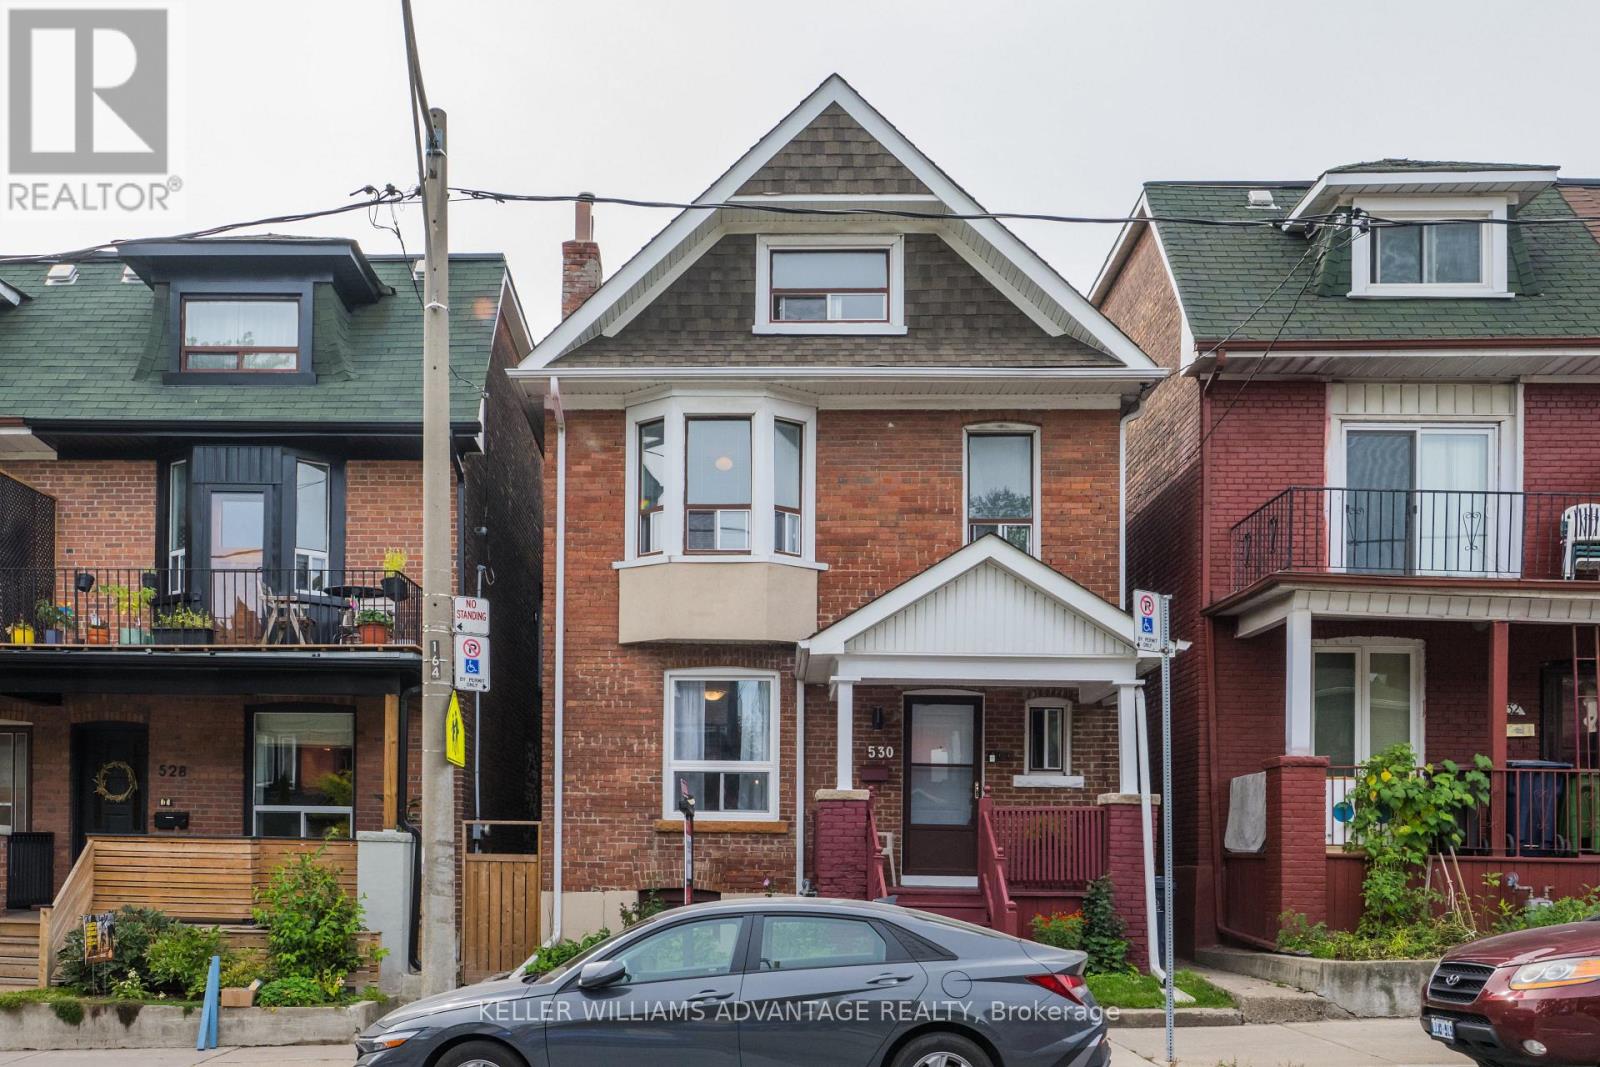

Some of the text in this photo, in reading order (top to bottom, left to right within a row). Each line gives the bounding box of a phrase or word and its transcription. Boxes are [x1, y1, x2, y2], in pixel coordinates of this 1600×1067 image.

[465, 600, 477, 609] NO
[456, 610, 487, 621] STANDING
[431, 641, 440, 678] 164
[868, 745, 894, 758] 530
[159, 764, 187, 777] 528
